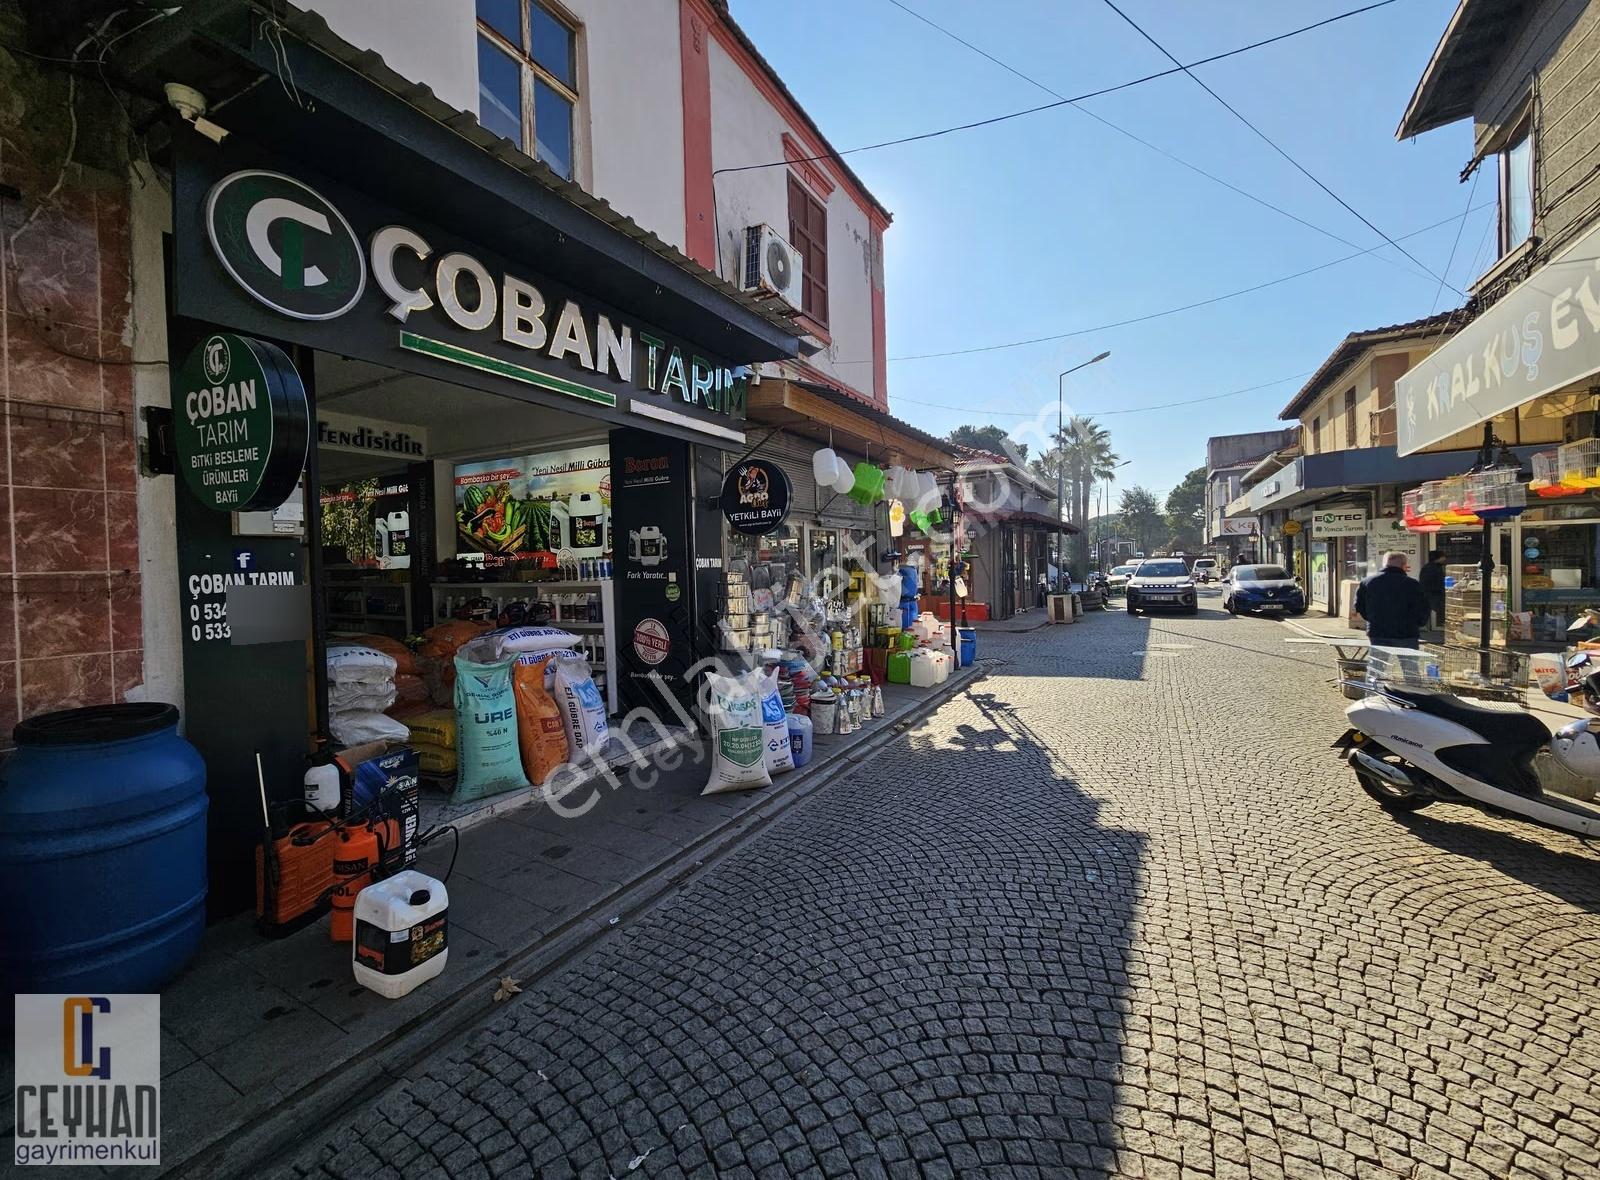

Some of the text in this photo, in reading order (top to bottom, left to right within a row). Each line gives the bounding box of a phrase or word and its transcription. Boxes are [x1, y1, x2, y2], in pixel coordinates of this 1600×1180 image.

[371, 225, 747, 420] ÇOBAN TARIM
[186, 379, 256, 425] ÇOBAN
[196, 418, 248, 448] TARIM
[191, 447, 259, 468] BİTKİ BESLEME
[550, 465, 567, 473] Nesil
[568, 461, 585, 472] Milli
[203, 469, 249, 486] ÜRÜNLERİ
[215, 489, 238, 504] BAYİİ
[729, 511, 759, 521] YETKİLİ
[1314, 513, 1362, 523] ENTEC
[189, 571, 295, 600] ÇOBAN TARIM
[190, 604, 199, 621] 0
[191, 624, 200, 641] 0
[568, 701, 581, 730] GÜBRE
[574, 730, 583, 749] DAP
